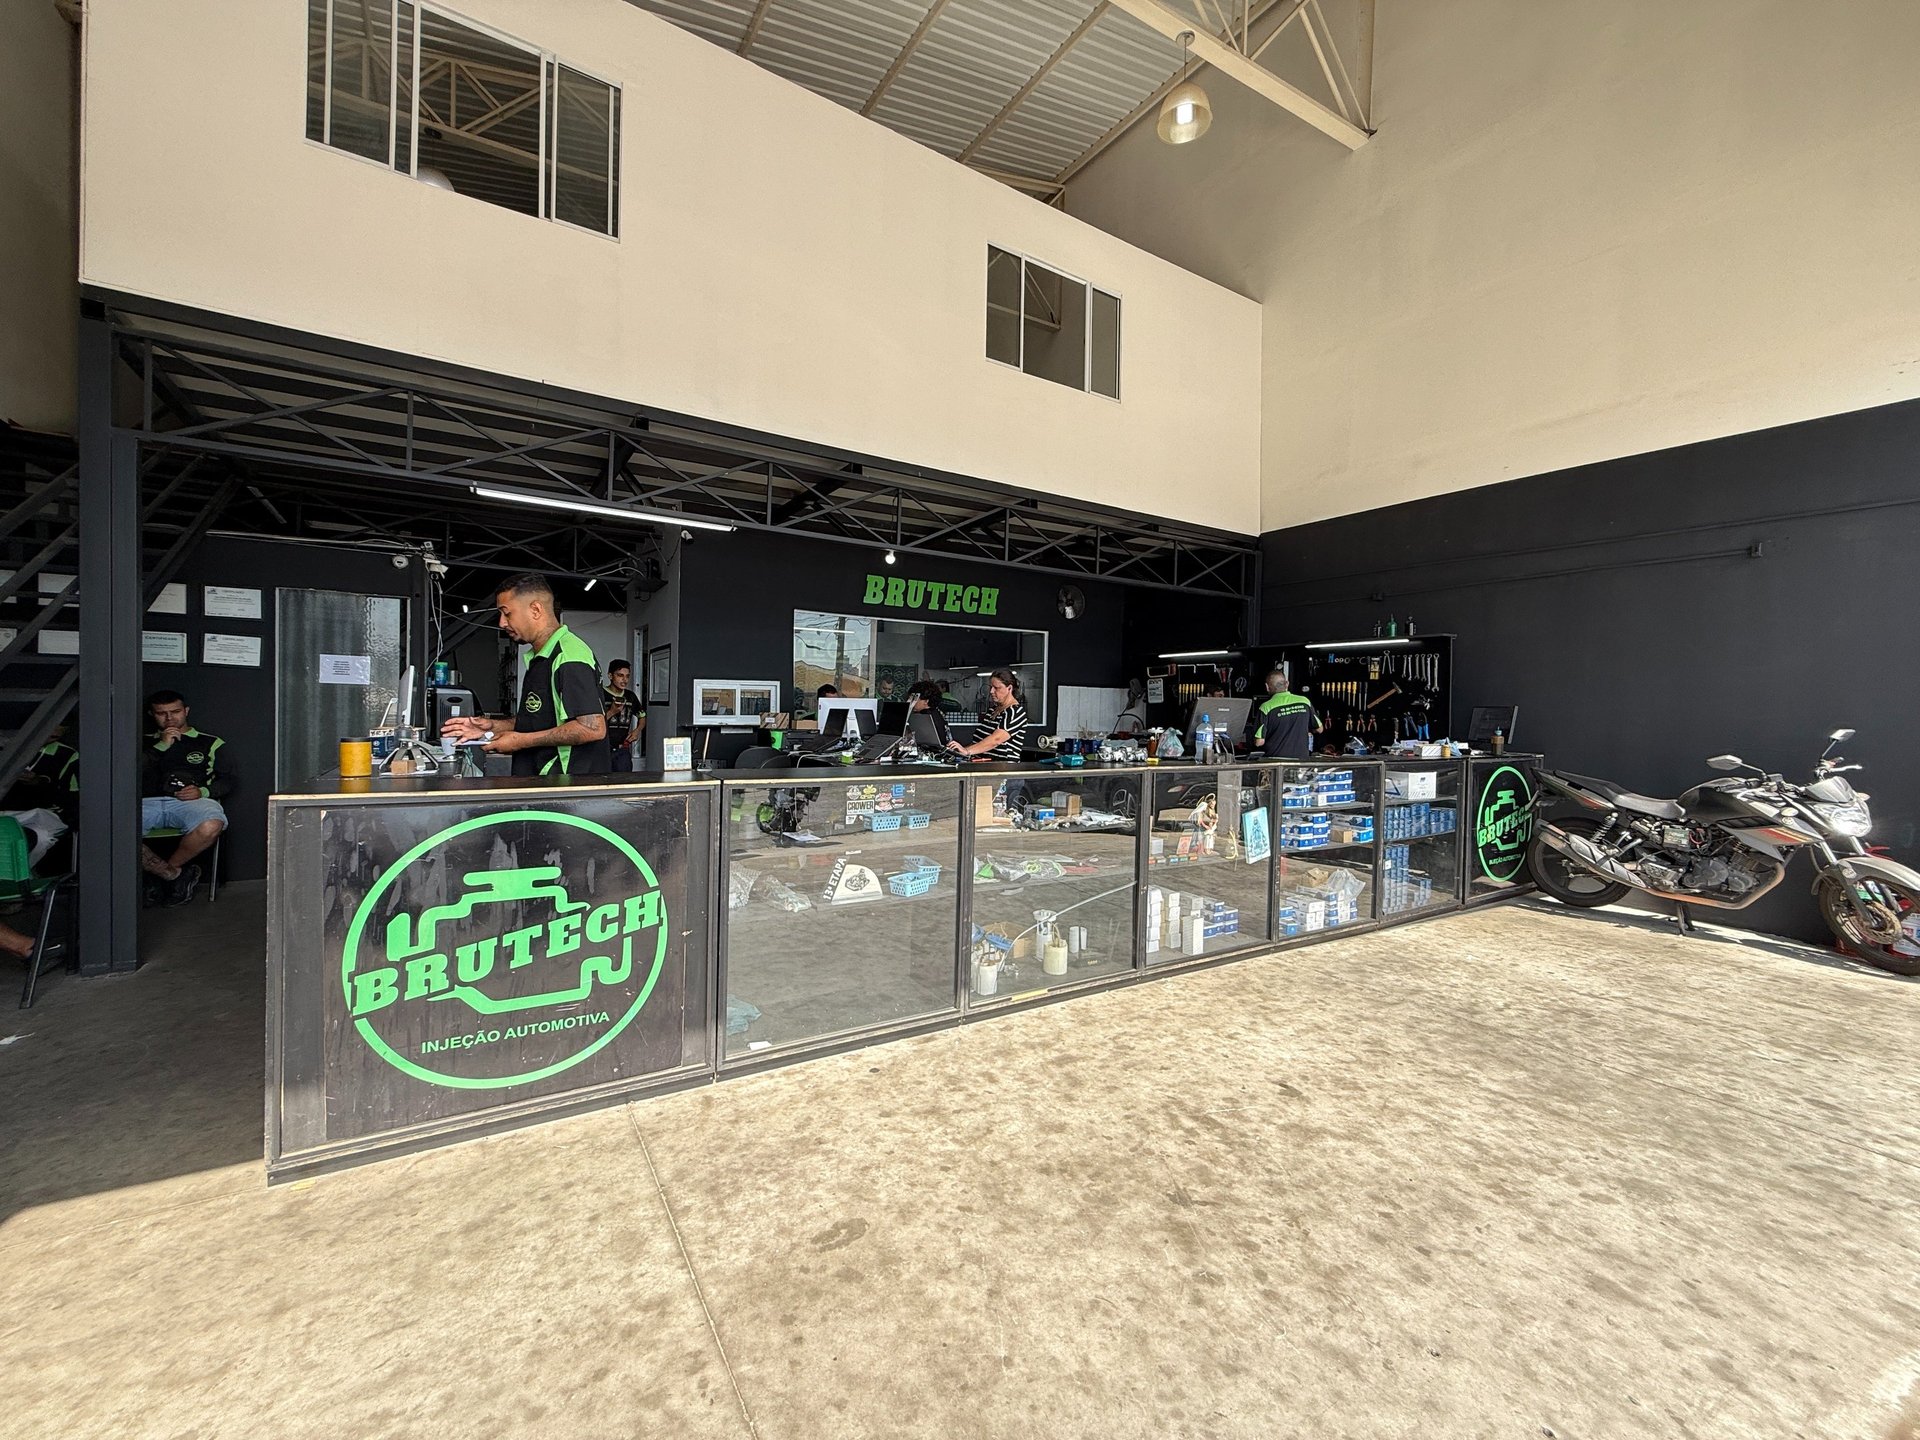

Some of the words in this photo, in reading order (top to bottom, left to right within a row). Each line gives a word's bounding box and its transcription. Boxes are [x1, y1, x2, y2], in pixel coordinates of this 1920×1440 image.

[863, 574, 1000, 615] BRUTECH
[828, 858, 847, 887] ETAPA
[352, 890, 662, 1016] BRUTECH
[421, 1030, 500, 1053] INJEÇÃO
[504, 1011, 610, 1039] AUTOMOTIVA
